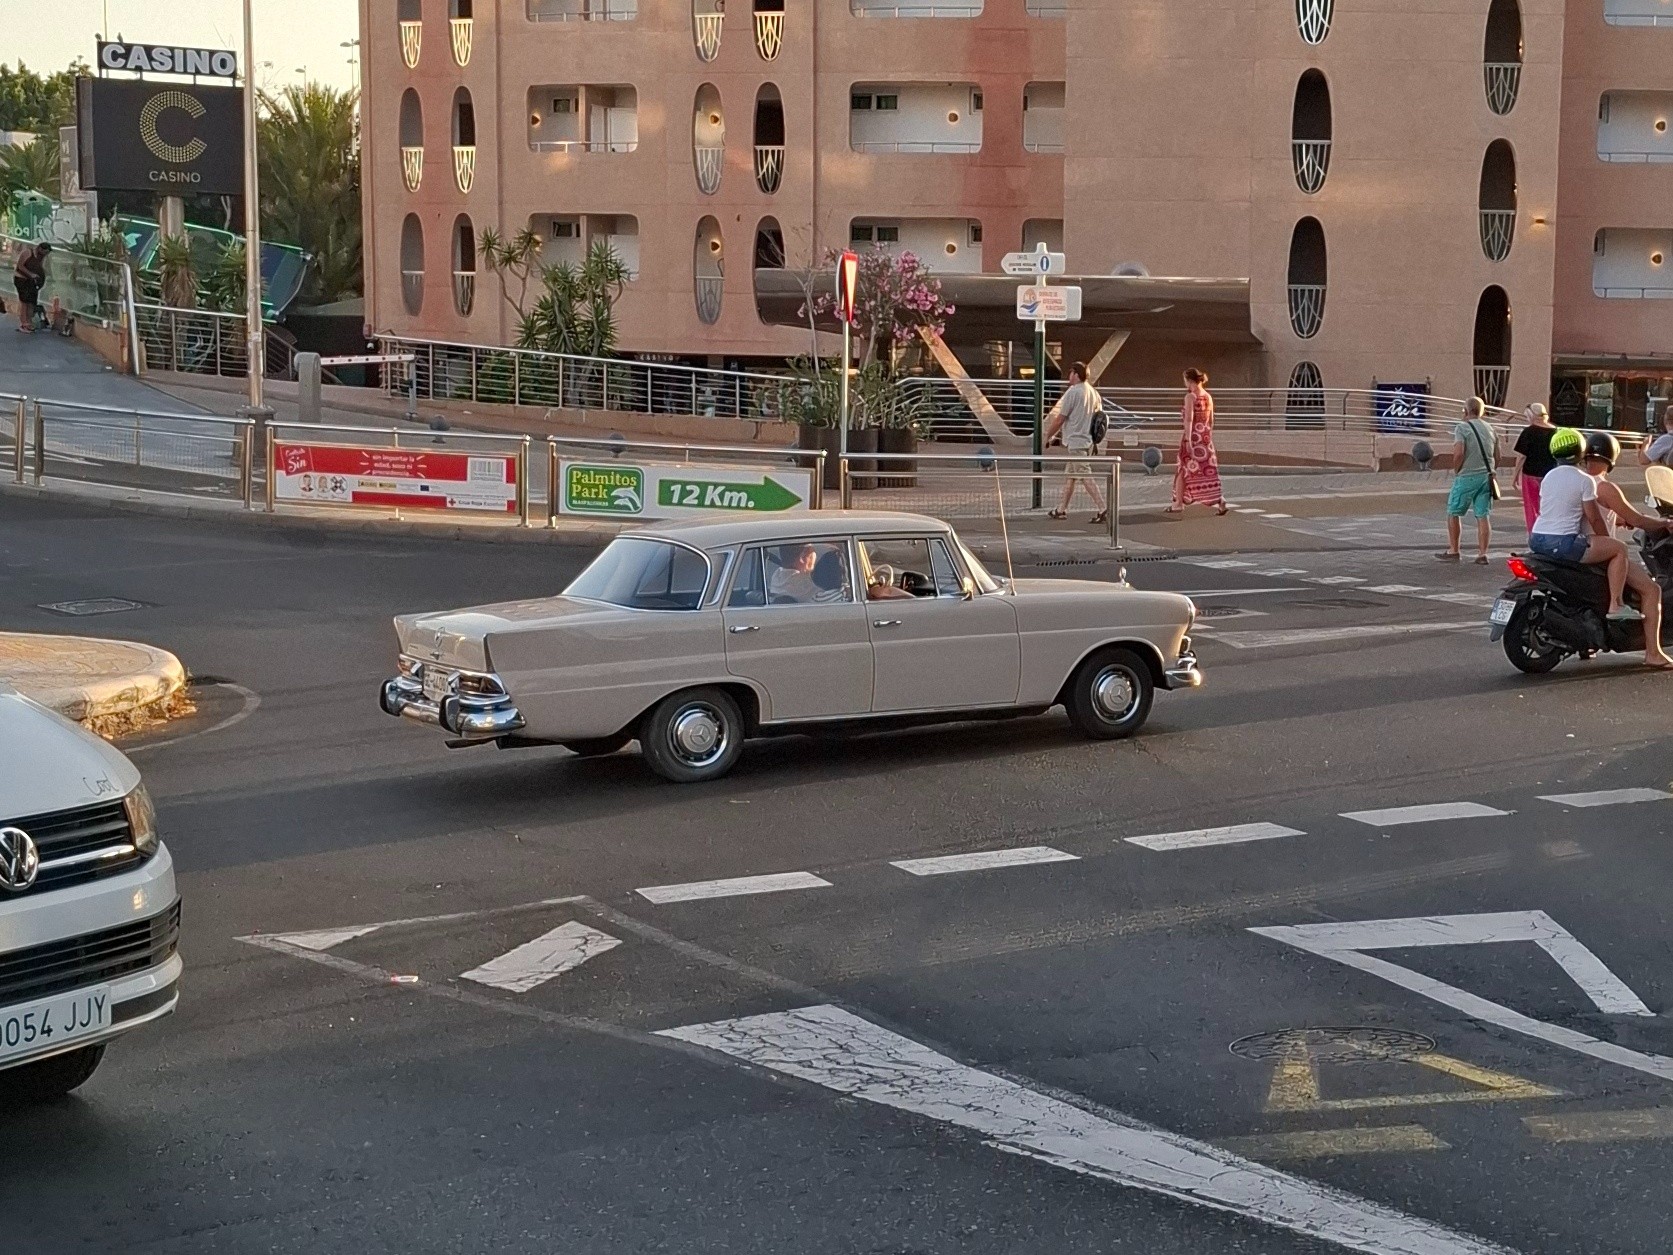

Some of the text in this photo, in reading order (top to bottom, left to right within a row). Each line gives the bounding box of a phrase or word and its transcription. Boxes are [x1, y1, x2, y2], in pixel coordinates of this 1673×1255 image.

[102, 44, 236, 76] CASINO
[149, 171, 201, 183] CASINO
[288, 456, 307, 473] Sin
[571, 470, 637, 486] Palmitos
[571, 484, 608, 499] Park
[670, 484, 755, 508] 12 Km.
[0, 994, 106, 1048] 054 JJY
